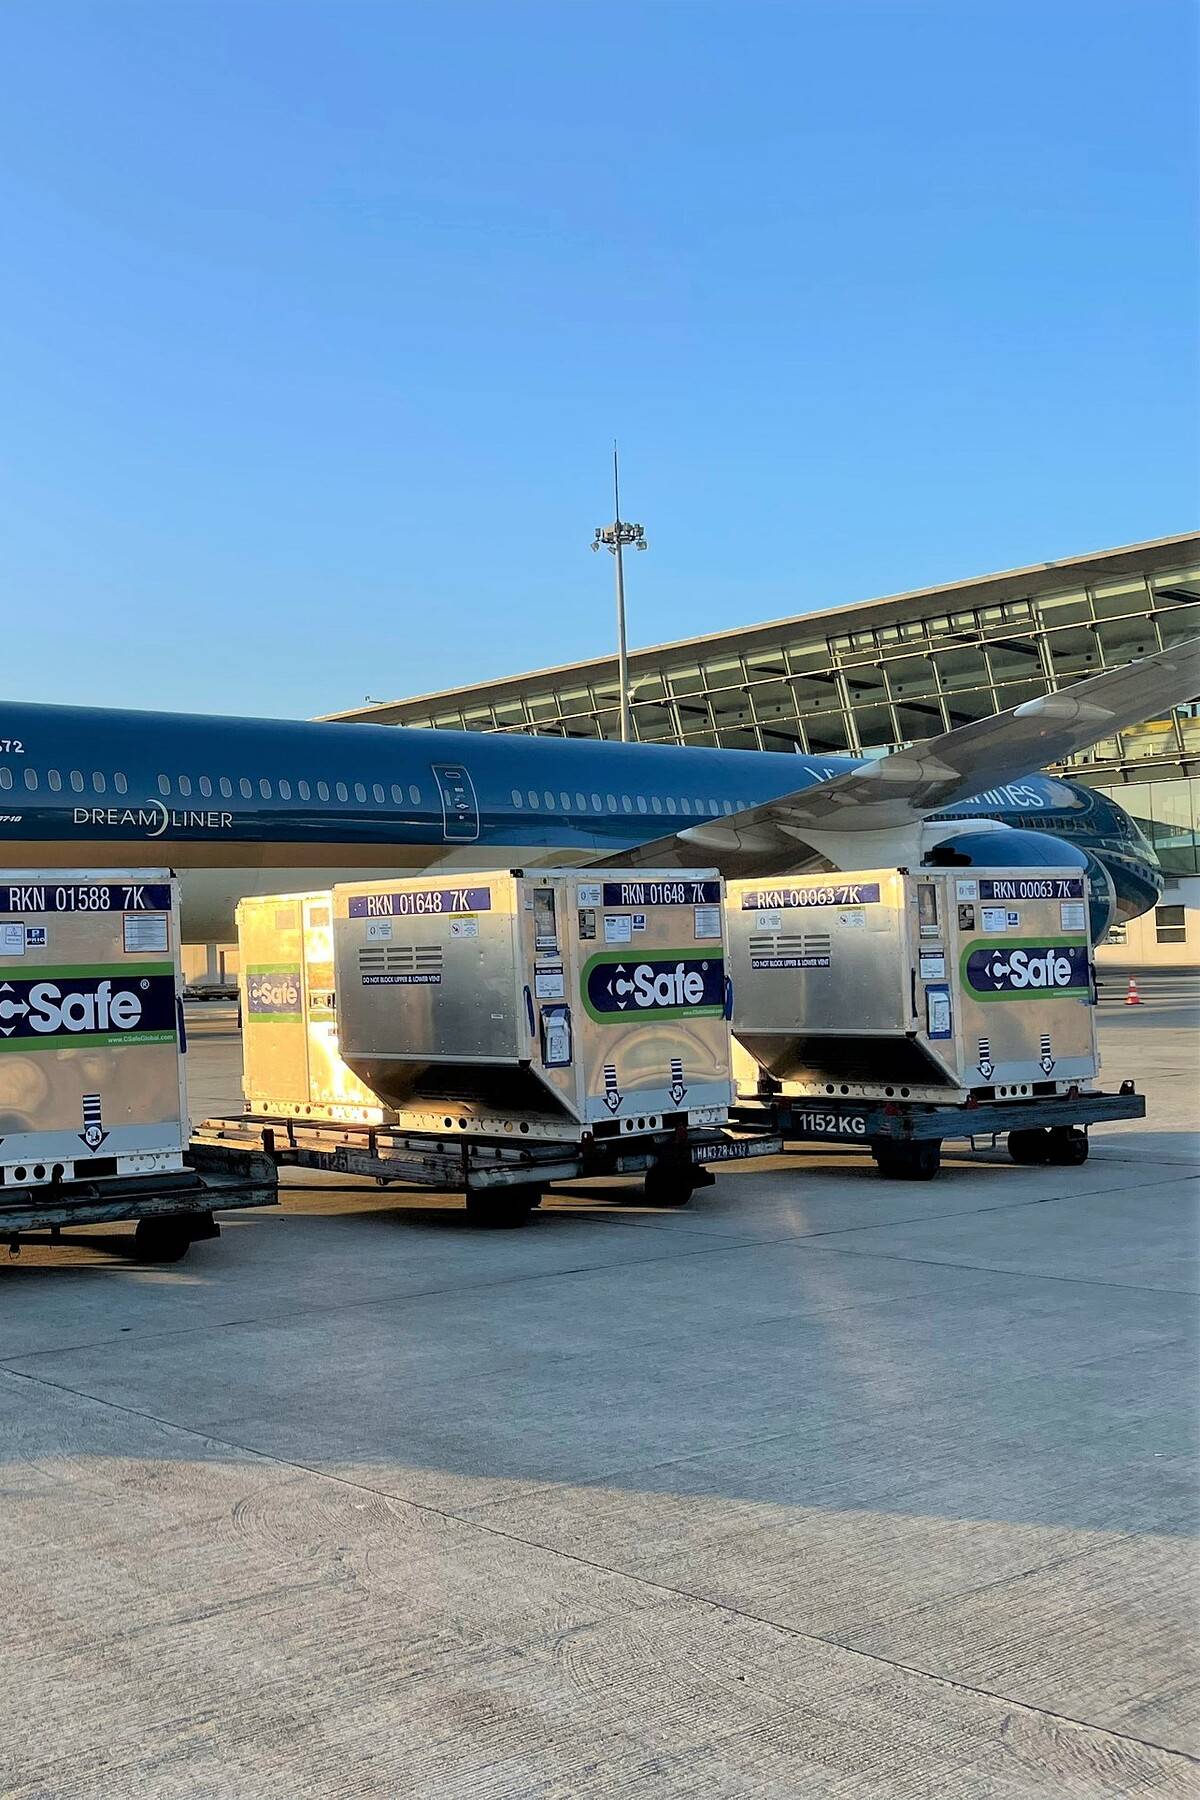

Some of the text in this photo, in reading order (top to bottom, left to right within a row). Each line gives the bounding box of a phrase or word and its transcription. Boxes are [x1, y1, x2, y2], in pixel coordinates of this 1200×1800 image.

[9, 886, 145, 911] RKN 01588 7K
[621, 884, 644, 904] RKN
[650, 884, 685, 904] 01648
[691, 883, 705, 902] 7K
[757, 886, 861, 908] RKN 00063 7K
[993, 882, 1016, 898] RKN
[1020, 881, 1053, 897] 00063
[1056, 881, 1071, 897] 7K
[367, 889, 470, 916] RKN 01648 7K
[800, 1114, 865, 1134] 1152KG
